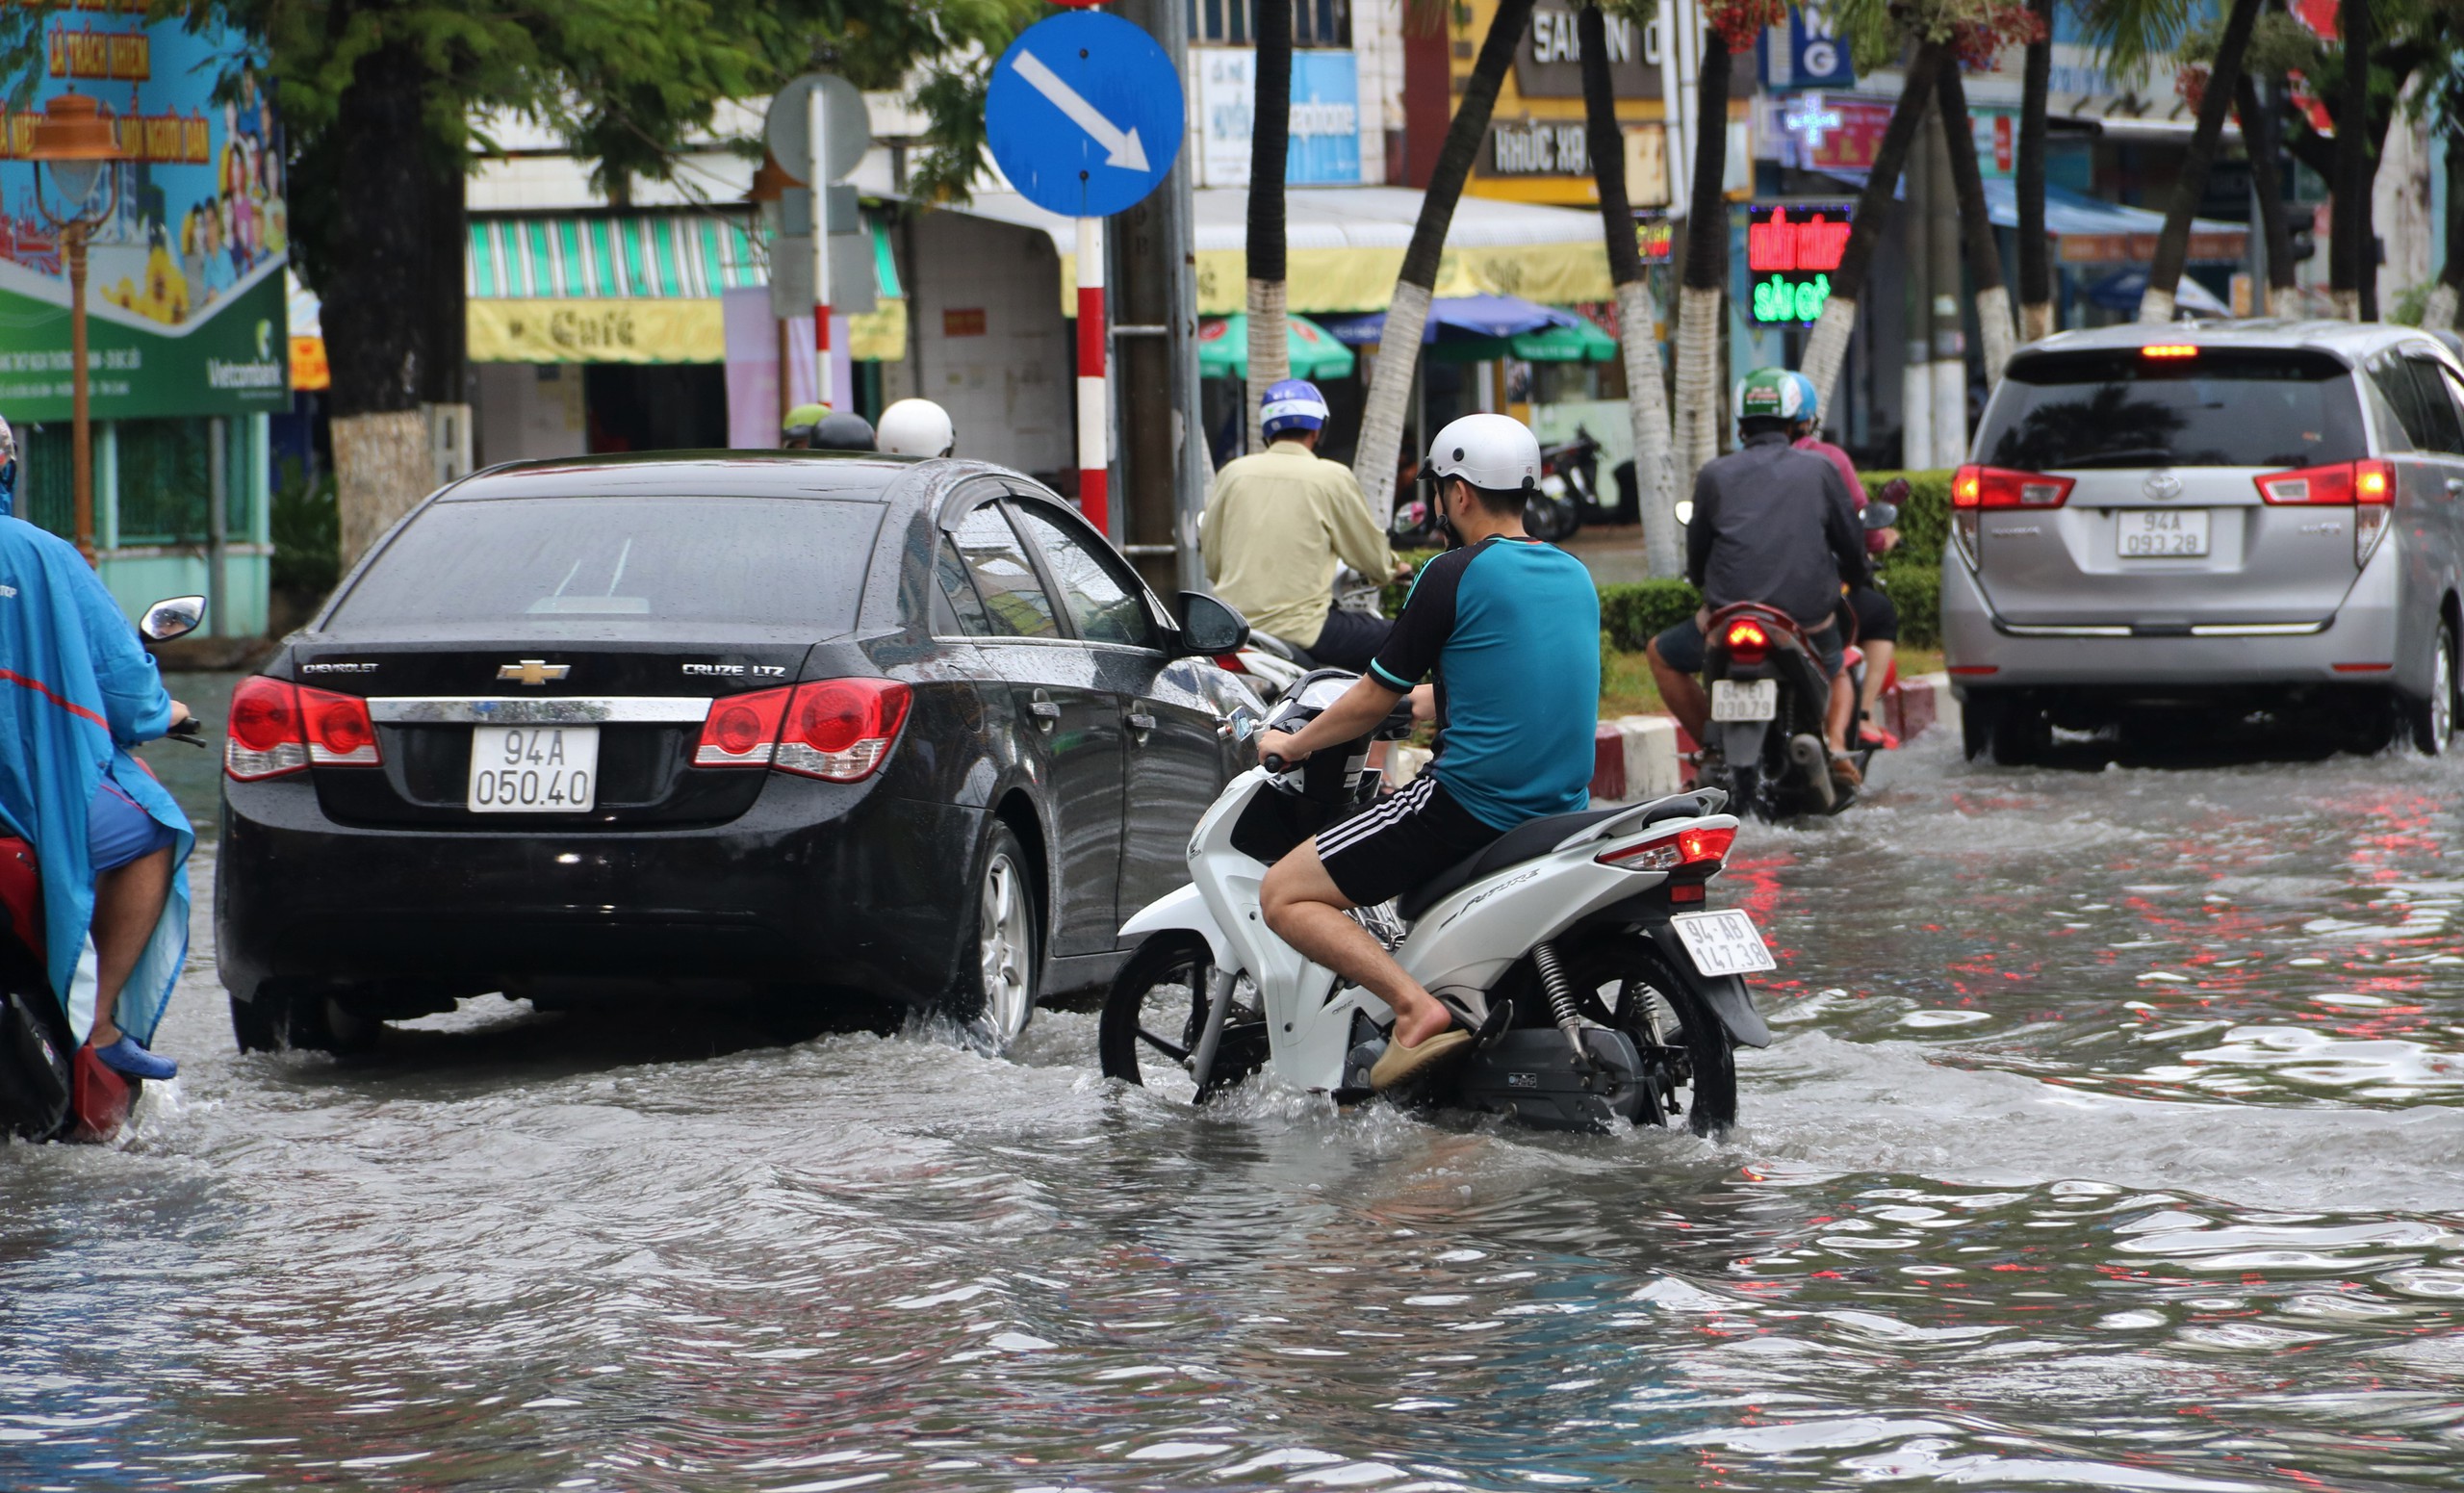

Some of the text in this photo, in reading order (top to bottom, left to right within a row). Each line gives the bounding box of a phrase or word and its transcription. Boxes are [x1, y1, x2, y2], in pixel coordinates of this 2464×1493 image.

[1754, 273, 1832, 322] SÀI GÒ
[550, 310, 635, 348] Café
[2143, 511, 2182, 532] 94A
[302, 662, 379, 674] CHEVROLET
[681, 663, 786, 678] CRUZE LTZ
[1716, 701, 1771, 719] 030.79
[504, 730, 565, 766] 94A
[476, 769, 588, 806] 050.40
[1685, 915, 1744, 944] 94-AB
[1696, 942, 1768, 971] 147.38
